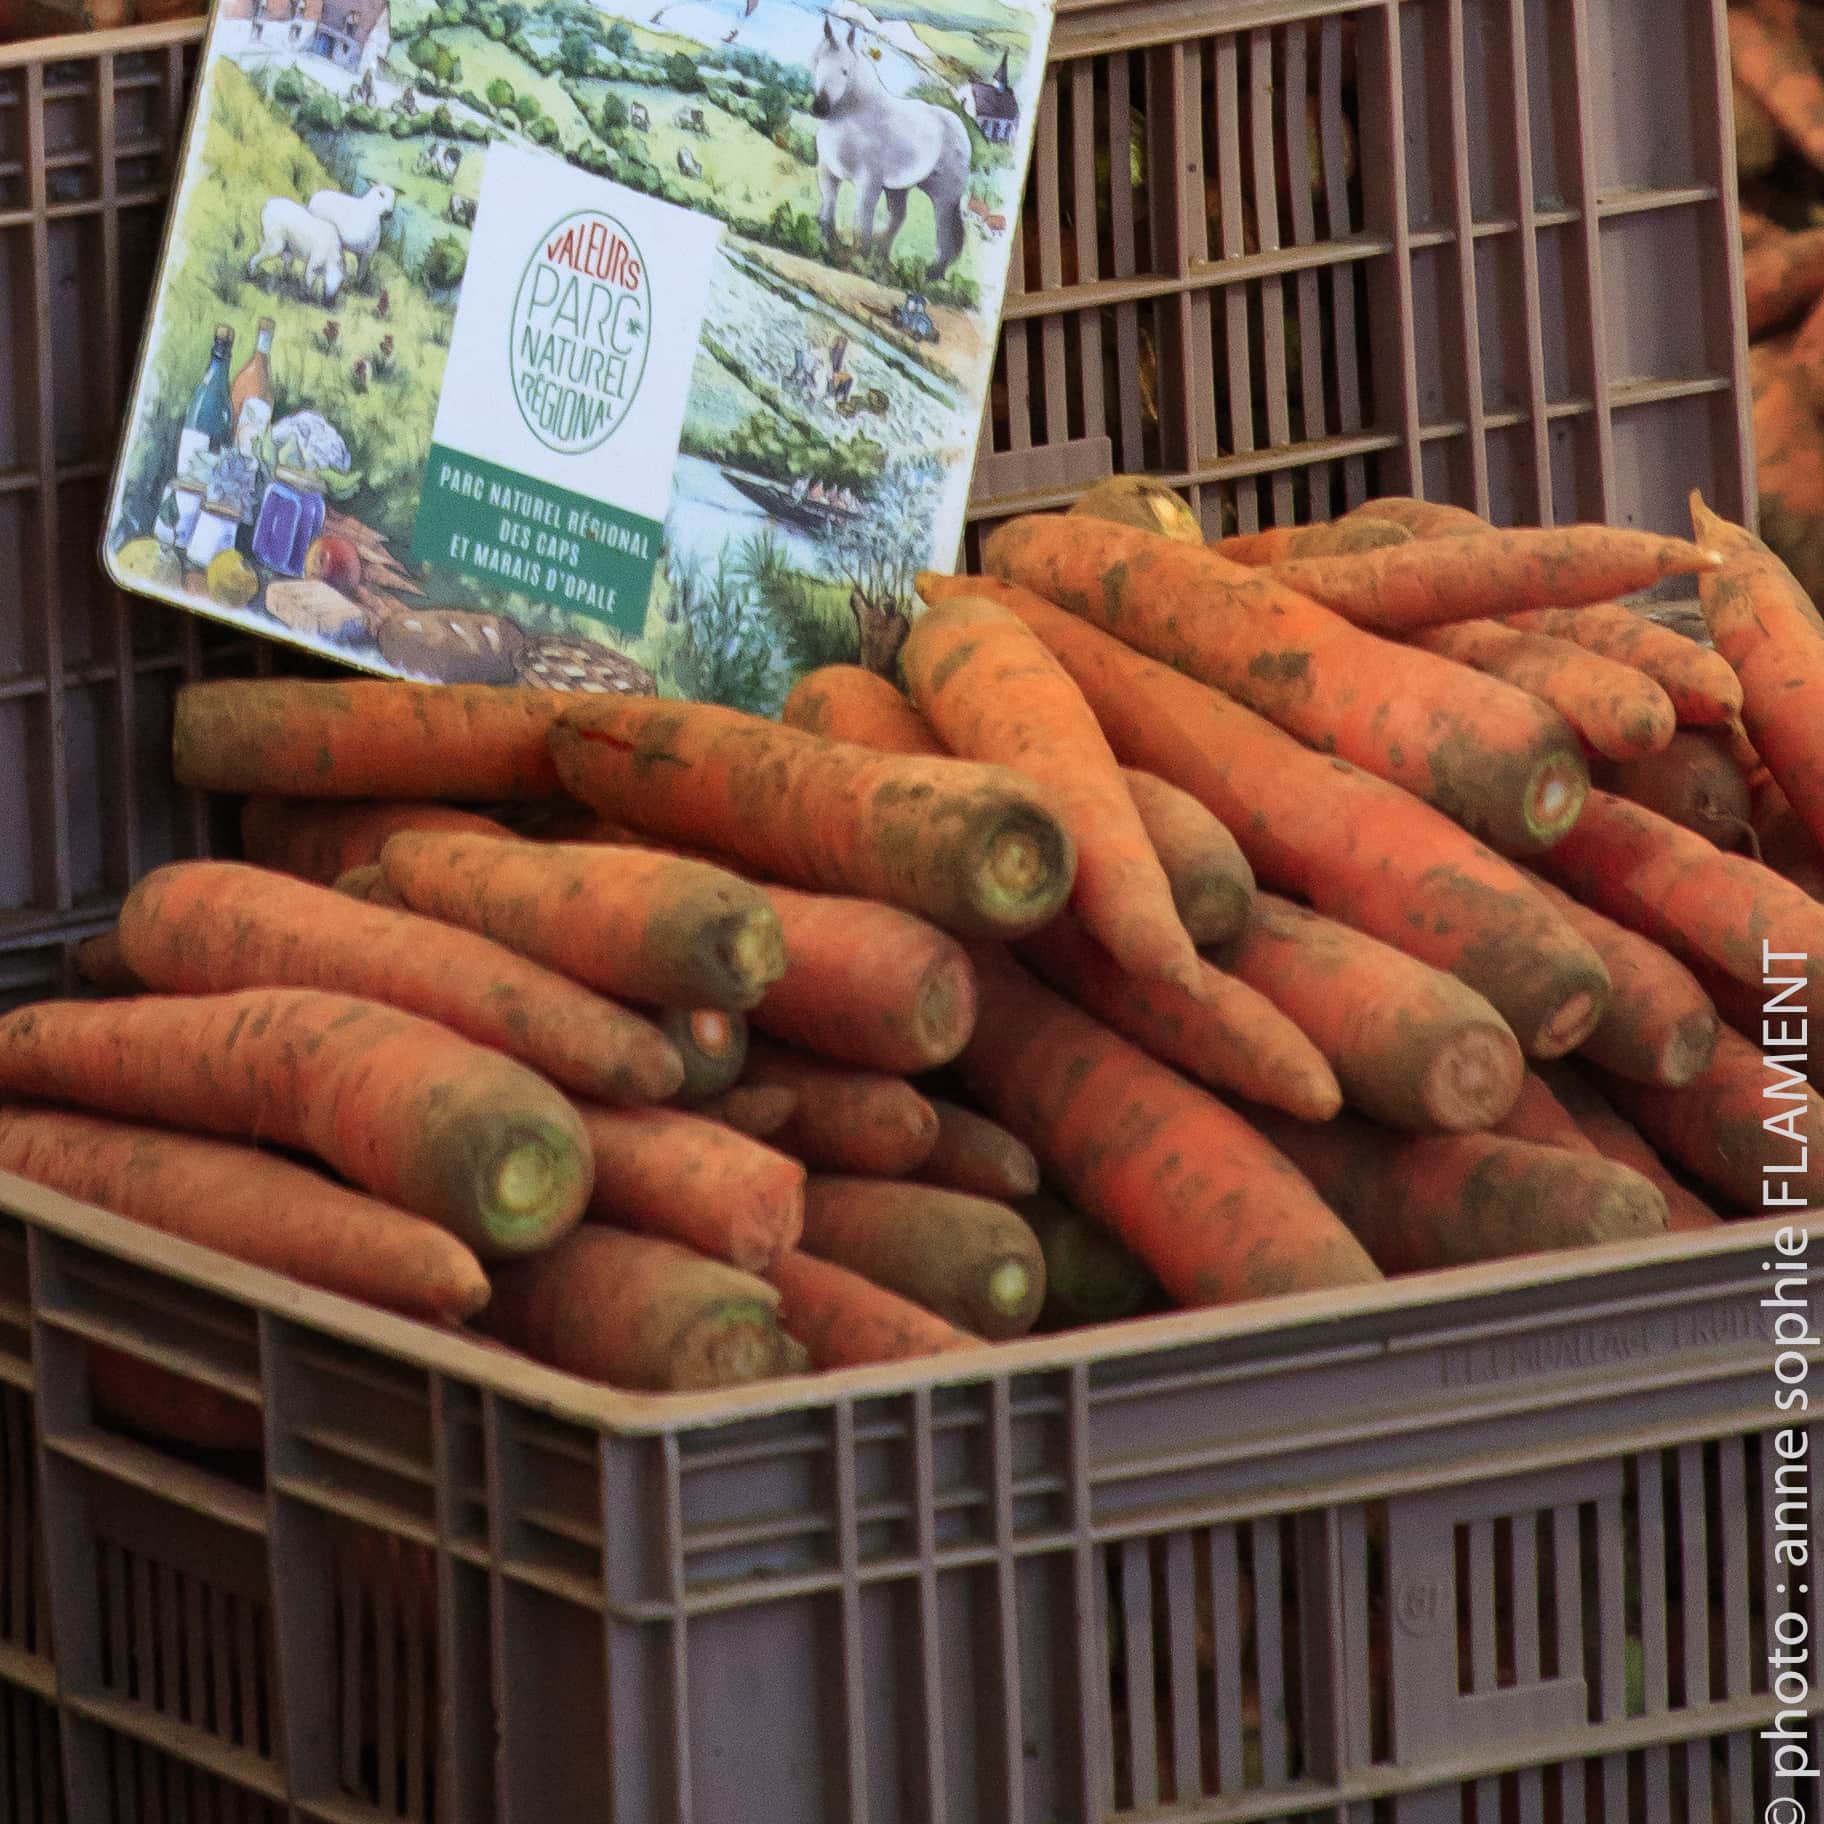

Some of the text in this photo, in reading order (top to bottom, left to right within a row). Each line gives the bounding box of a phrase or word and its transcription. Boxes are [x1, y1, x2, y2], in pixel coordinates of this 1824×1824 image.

[547, 220, 640, 291] VALEURS
[528, 263, 641, 355] PARC
[521, 324, 627, 400] NATUREL
[521, 370, 613, 441] RÉGIONAL
[440, 463, 649, 560] PARC NATUREL RÉGIONAL
[498, 517, 580, 567] DES CAPS
[450, 533, 617, 614] ET MARAIS D'OPALE
